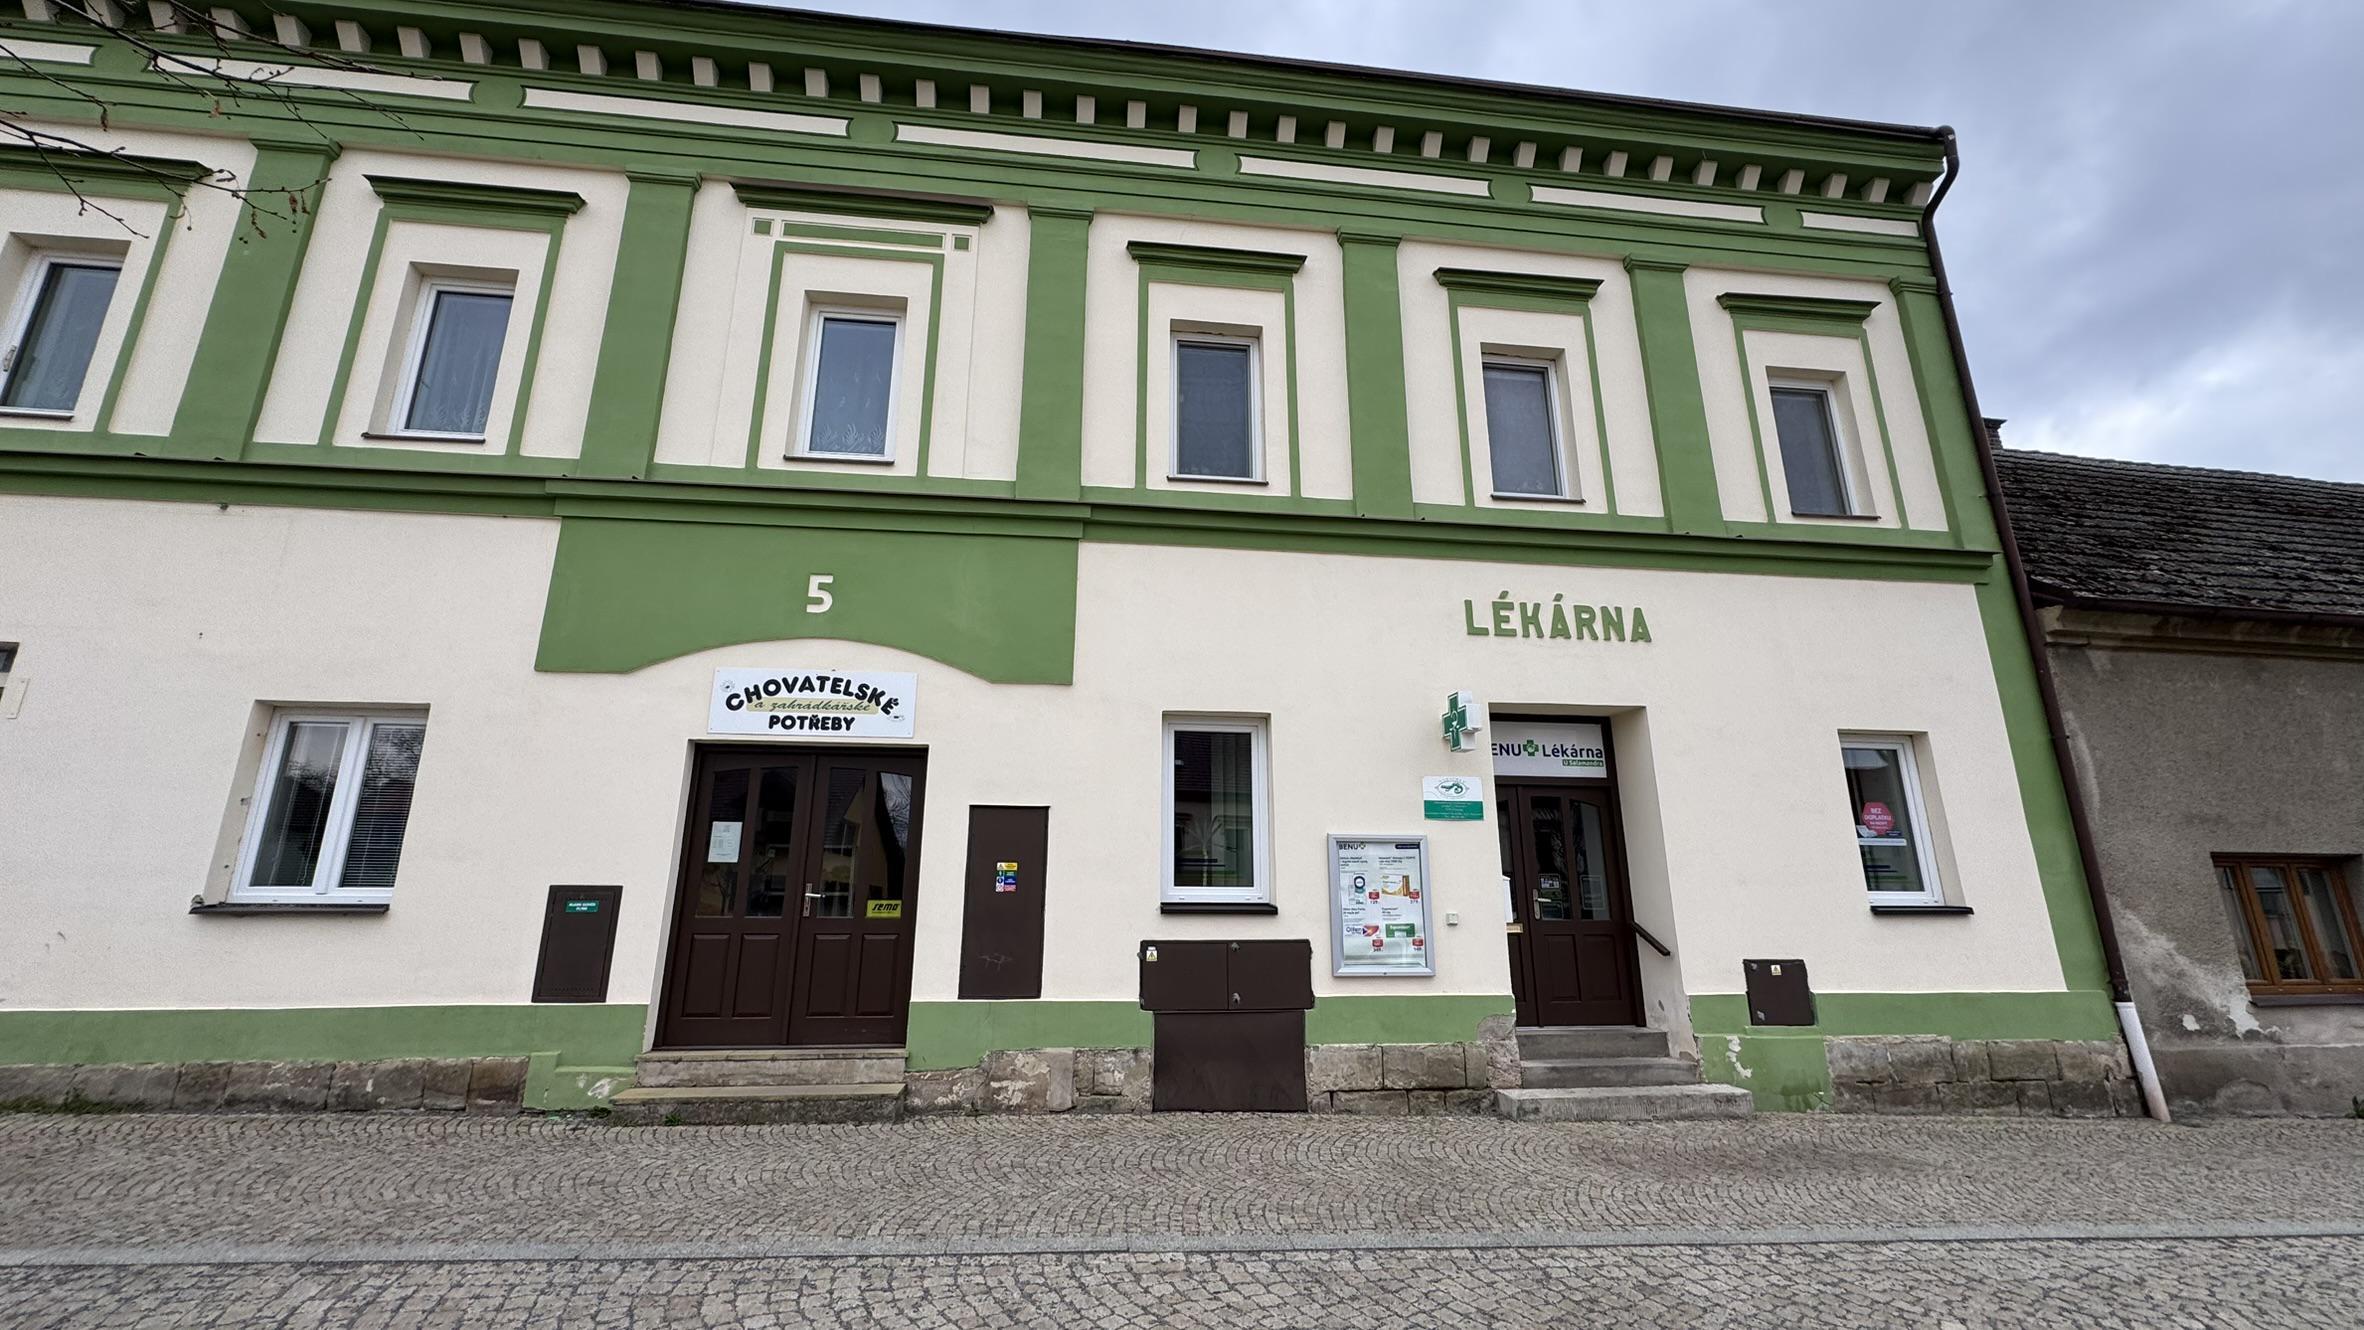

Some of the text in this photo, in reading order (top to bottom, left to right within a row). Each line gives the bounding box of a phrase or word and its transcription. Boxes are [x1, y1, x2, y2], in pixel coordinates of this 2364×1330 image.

[806, 574, 834, 613] 5
[1464, 590, 1652, 642] LÉKÁRNA
[725, 675, 899, 715] CHOVATELSKÉ
[768, 714, 855, 731] POTŘEBY
[1491, 743, 1603, 759] ENU Lékárna
[872, 903, 900, 911] semo
